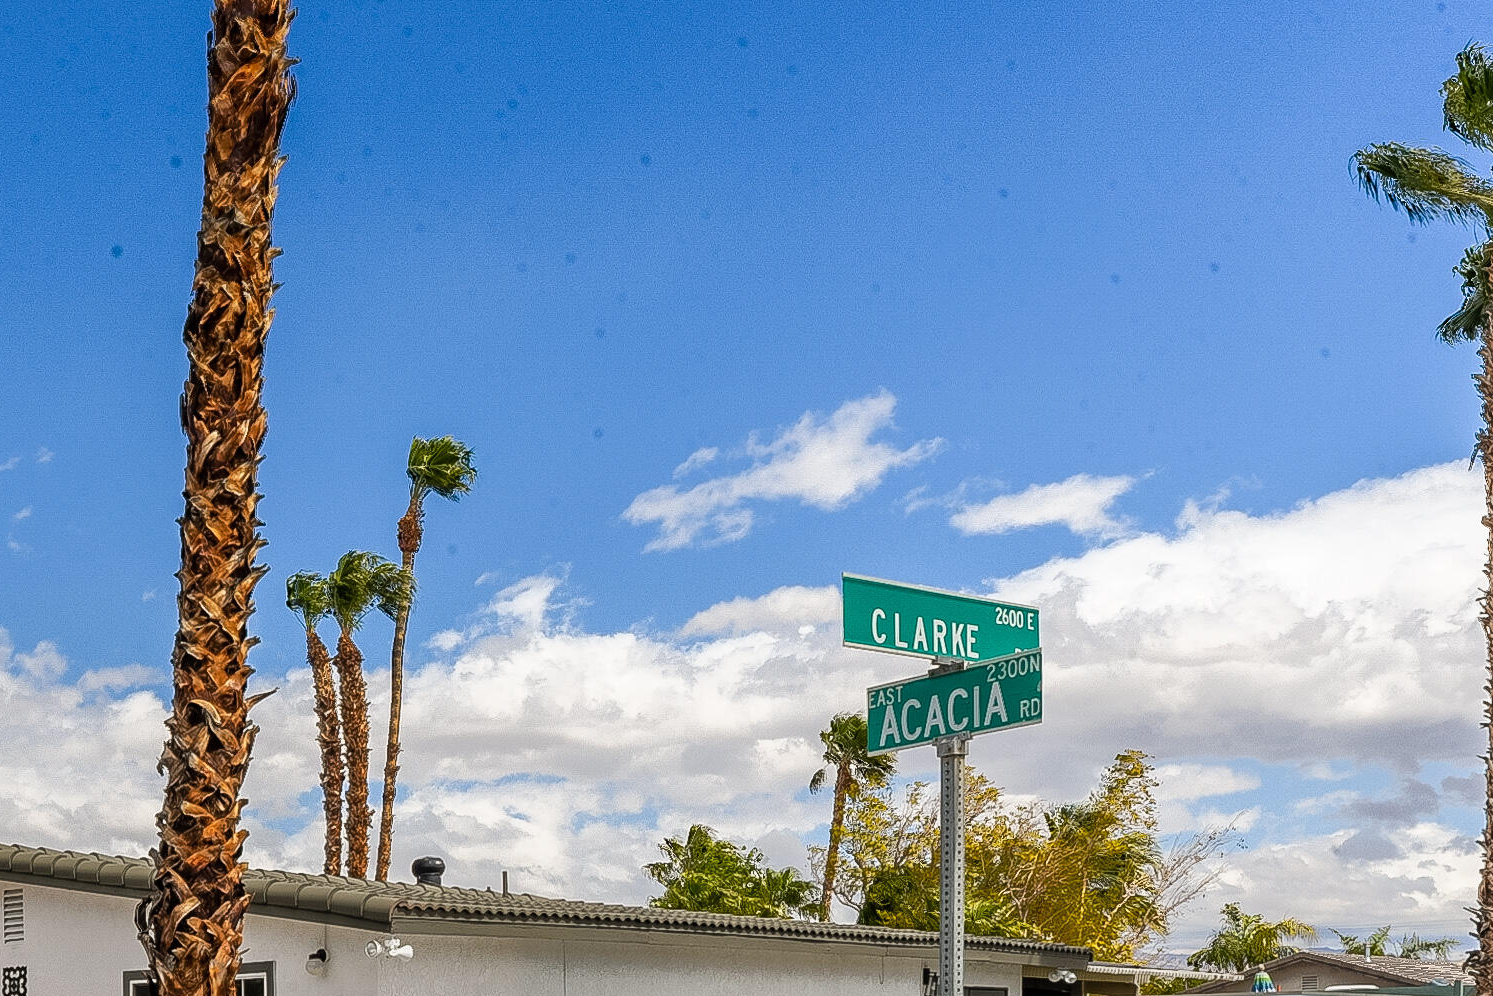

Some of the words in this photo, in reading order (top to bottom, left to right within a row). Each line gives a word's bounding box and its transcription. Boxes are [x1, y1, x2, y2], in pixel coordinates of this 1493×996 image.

[871, 607, 980, 659] CLARKE
[995, 606, 1024, 629] 2600
[1027, 613, 1035, 631] E
[868, 686, 904, 709] EAST
[879, 682, 1009, 747] ACACIA
[1019, 697, 1041, 719] RD
